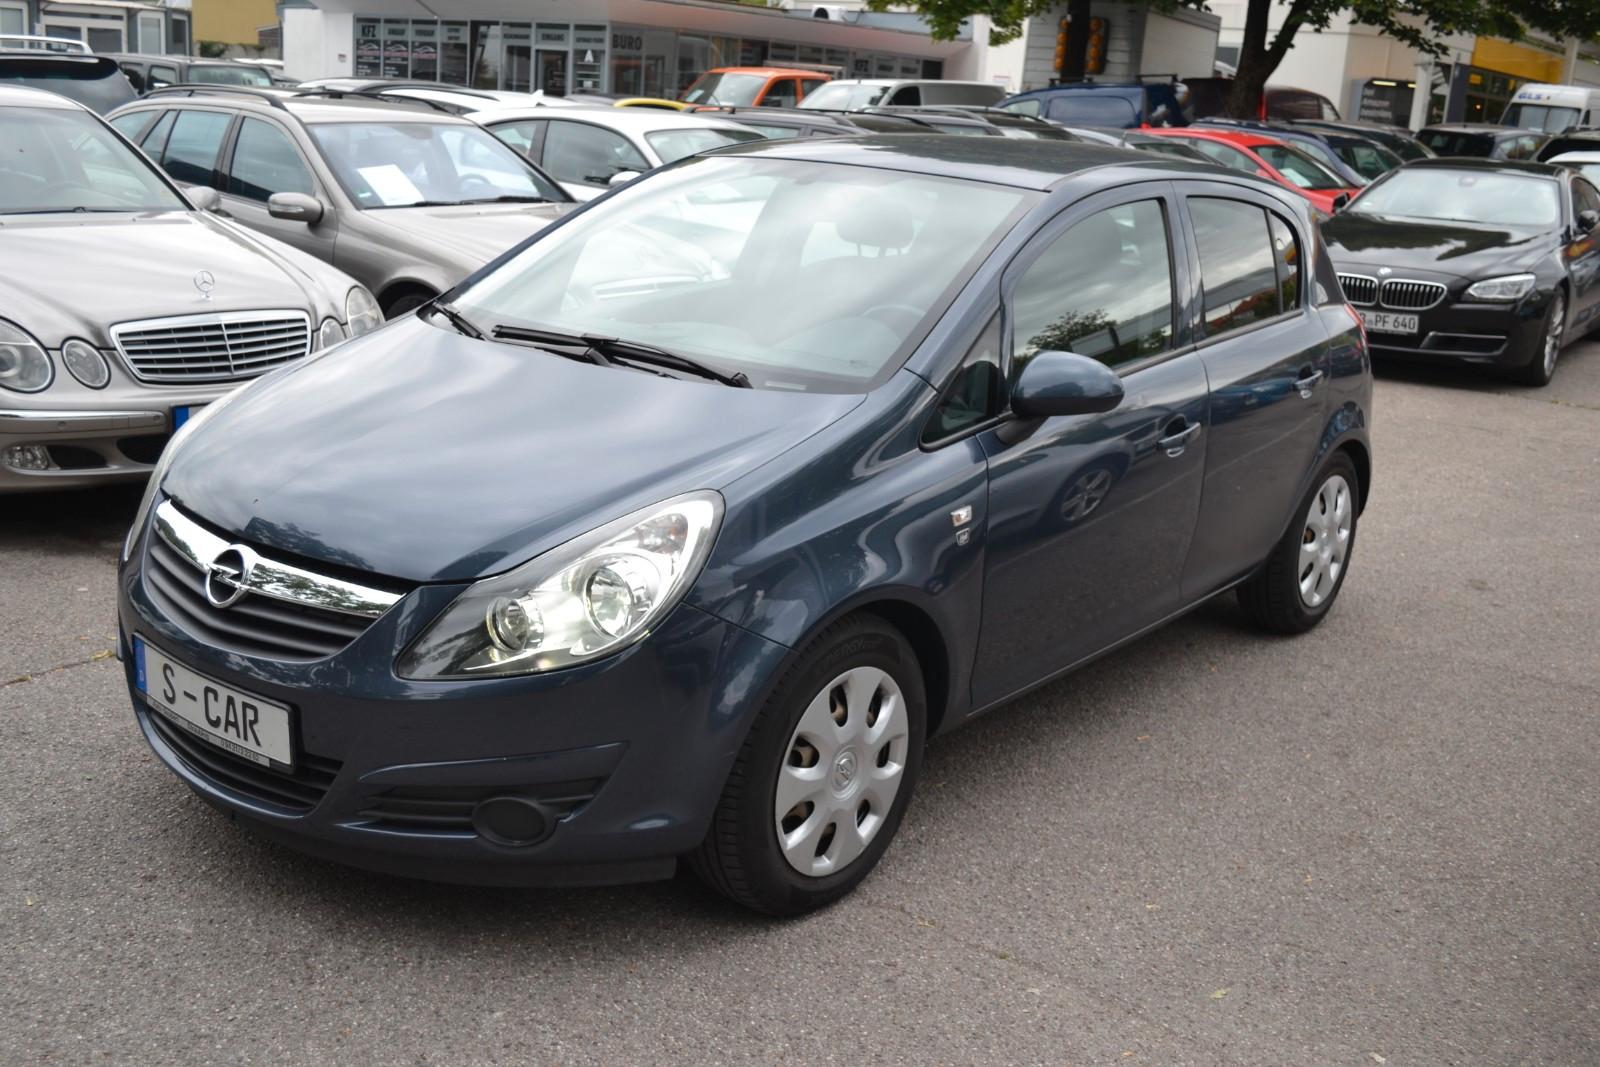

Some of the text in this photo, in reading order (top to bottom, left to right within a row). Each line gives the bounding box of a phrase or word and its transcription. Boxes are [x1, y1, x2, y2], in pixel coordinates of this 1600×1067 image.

[361, 24, 376, 37] KFZ
[1375, 314, 1390, 327] PF
[1393, 316, 1416, 330] 640
[162, 663, 261, 748] S-CAR
